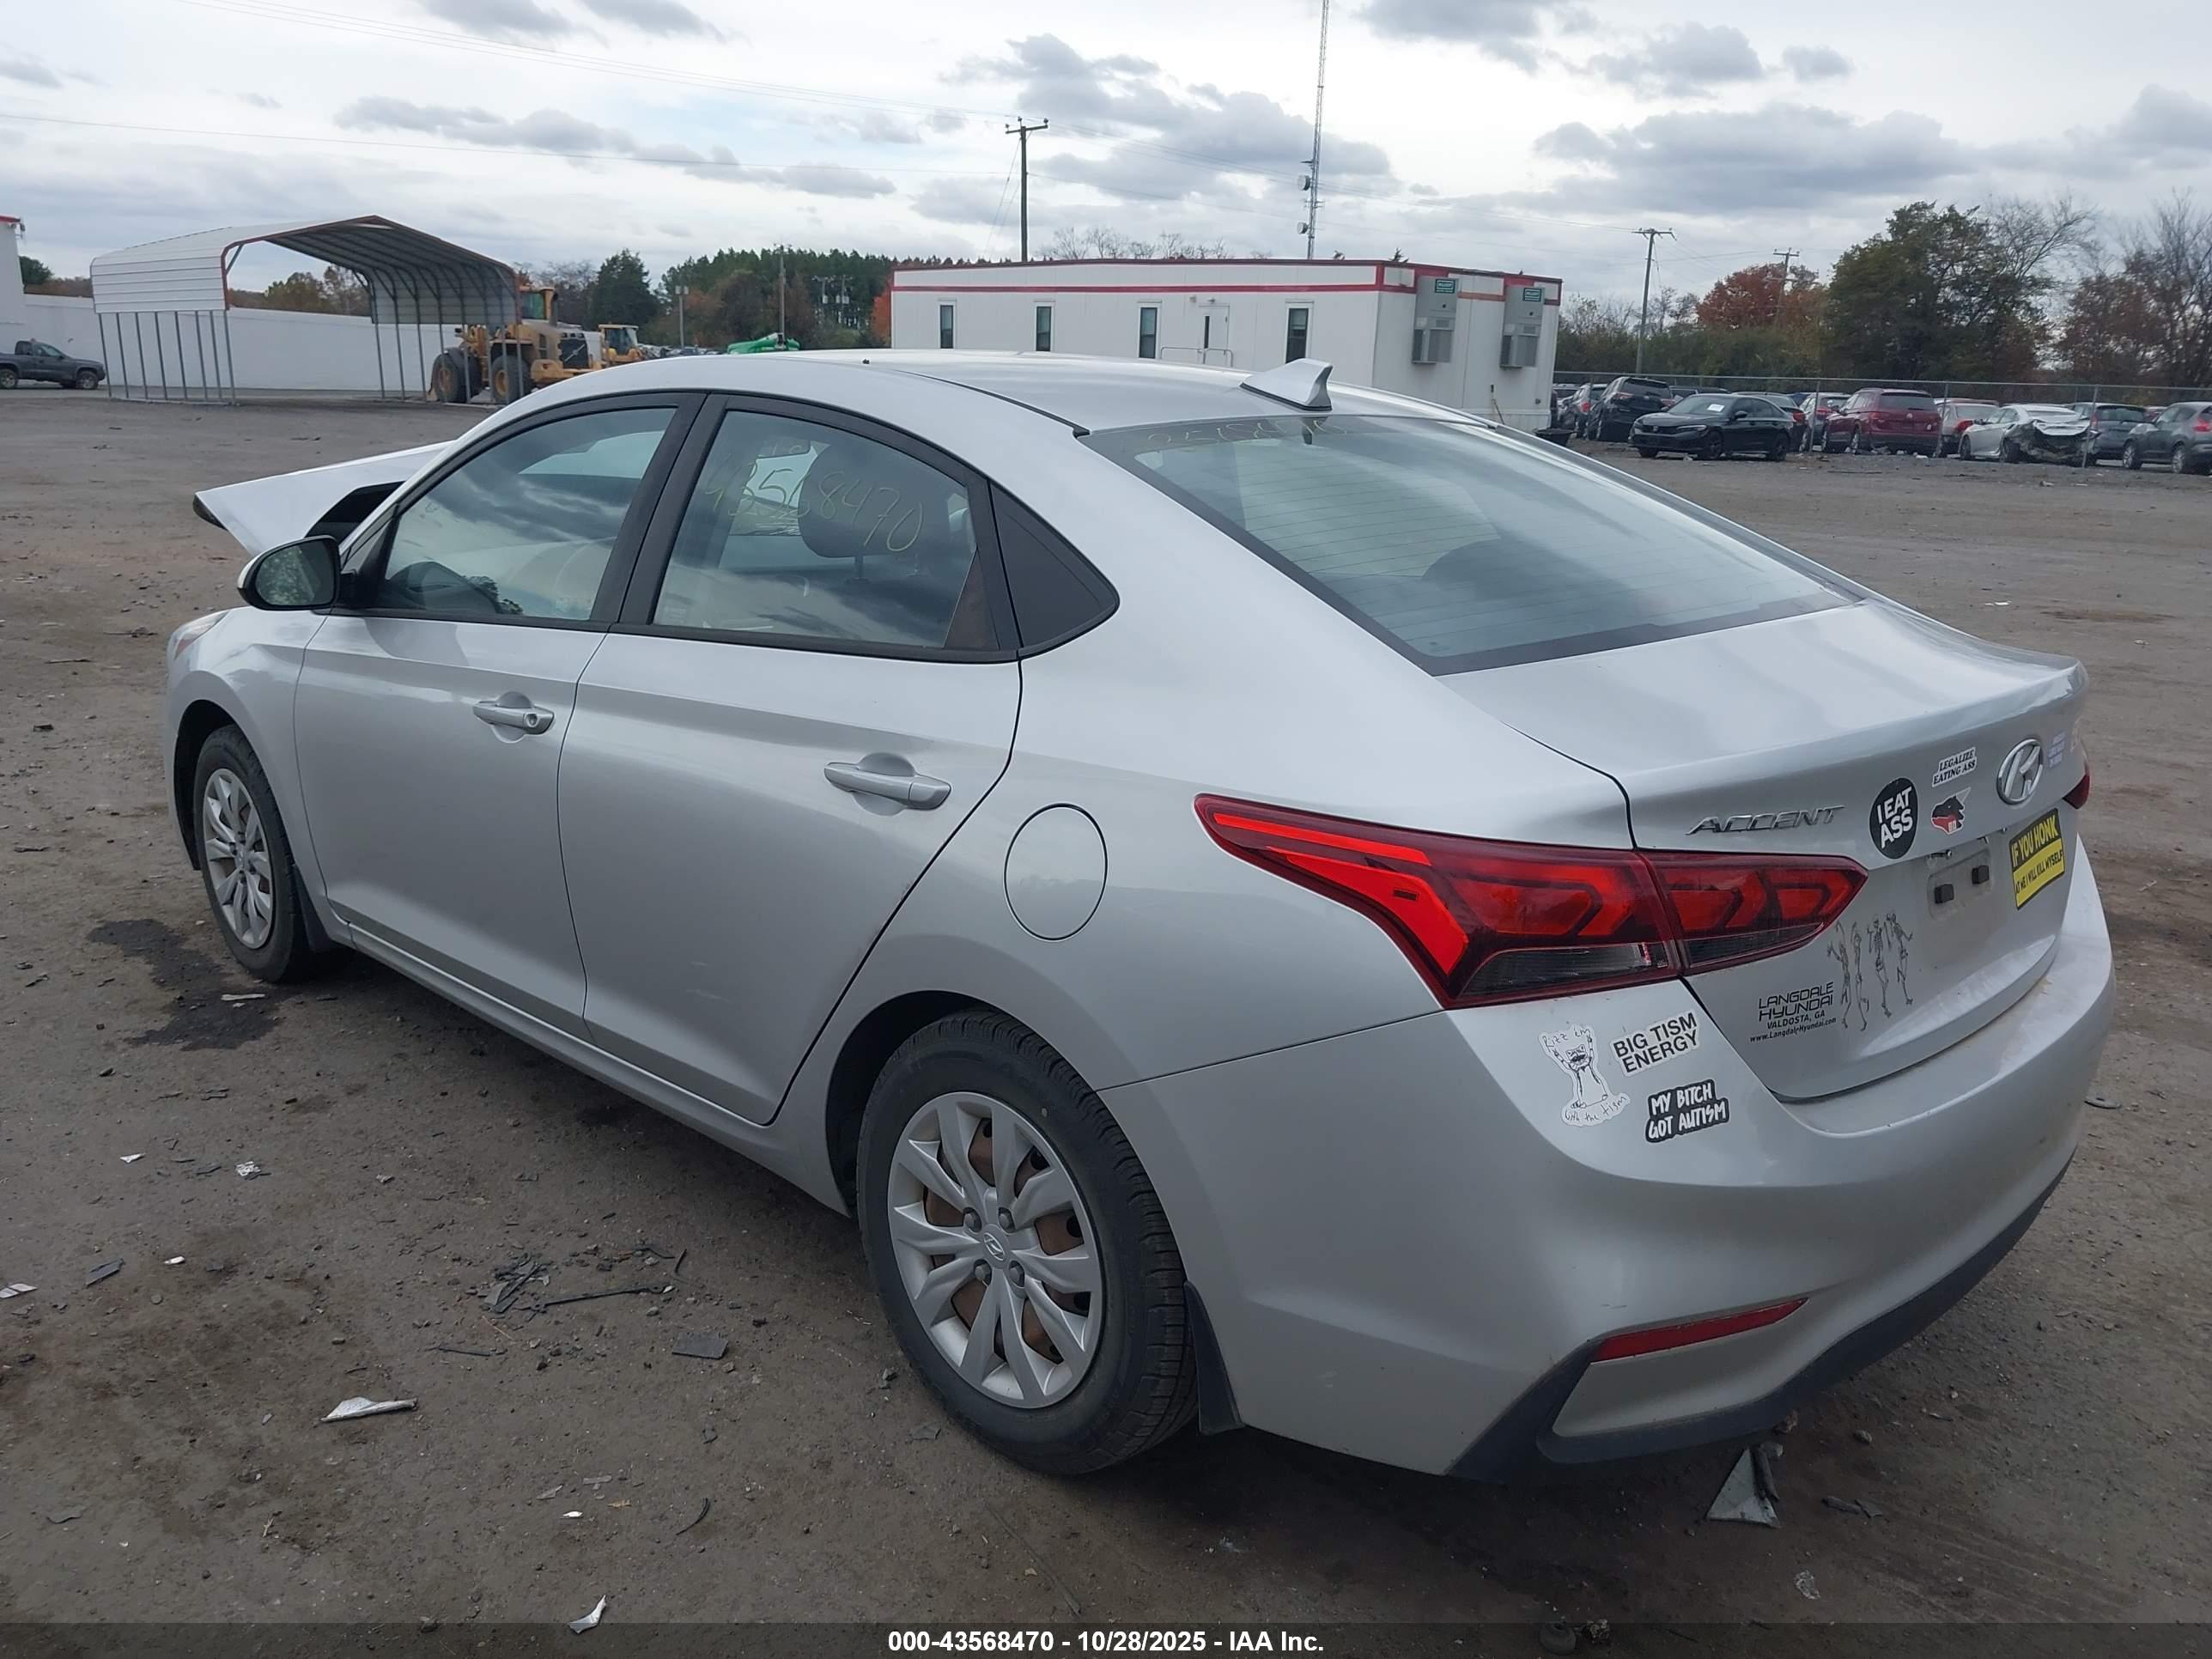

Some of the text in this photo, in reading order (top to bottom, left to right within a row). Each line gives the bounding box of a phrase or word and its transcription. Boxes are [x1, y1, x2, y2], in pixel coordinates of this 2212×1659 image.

[1933, 759, 1976, 785] EATING ASS
[1940, 750, 1974, 771] LEGALIZE
[1685, 805, 1845, 836] ACCENT
[1876, 786, 1912, 823] I EAT
[1881, 808, 1913, 848] ASS
[2011, 814, 2059, 867] IF YOU HONK
[2028, 869, 2038, 883] WILL
[2037, 862, 2046, 876] KILL
[2045, 849, 2063, 870] MYSELF
[1759, 981, 1833, 1009] LANGDALE
[1759, 994, 1833, 1022] HYUNDAI
[1613, 1012, 1698, 1058] BIG TISM
[1767, 1010, 1826, 1030] VALDOSTA, GA
[1622, 1030, 1698, 1073] ENERGY
[1650, 1083, 1713, 1115] MY BITCH
[1648, 1101, 1727, 1139] GOT AUTISM
